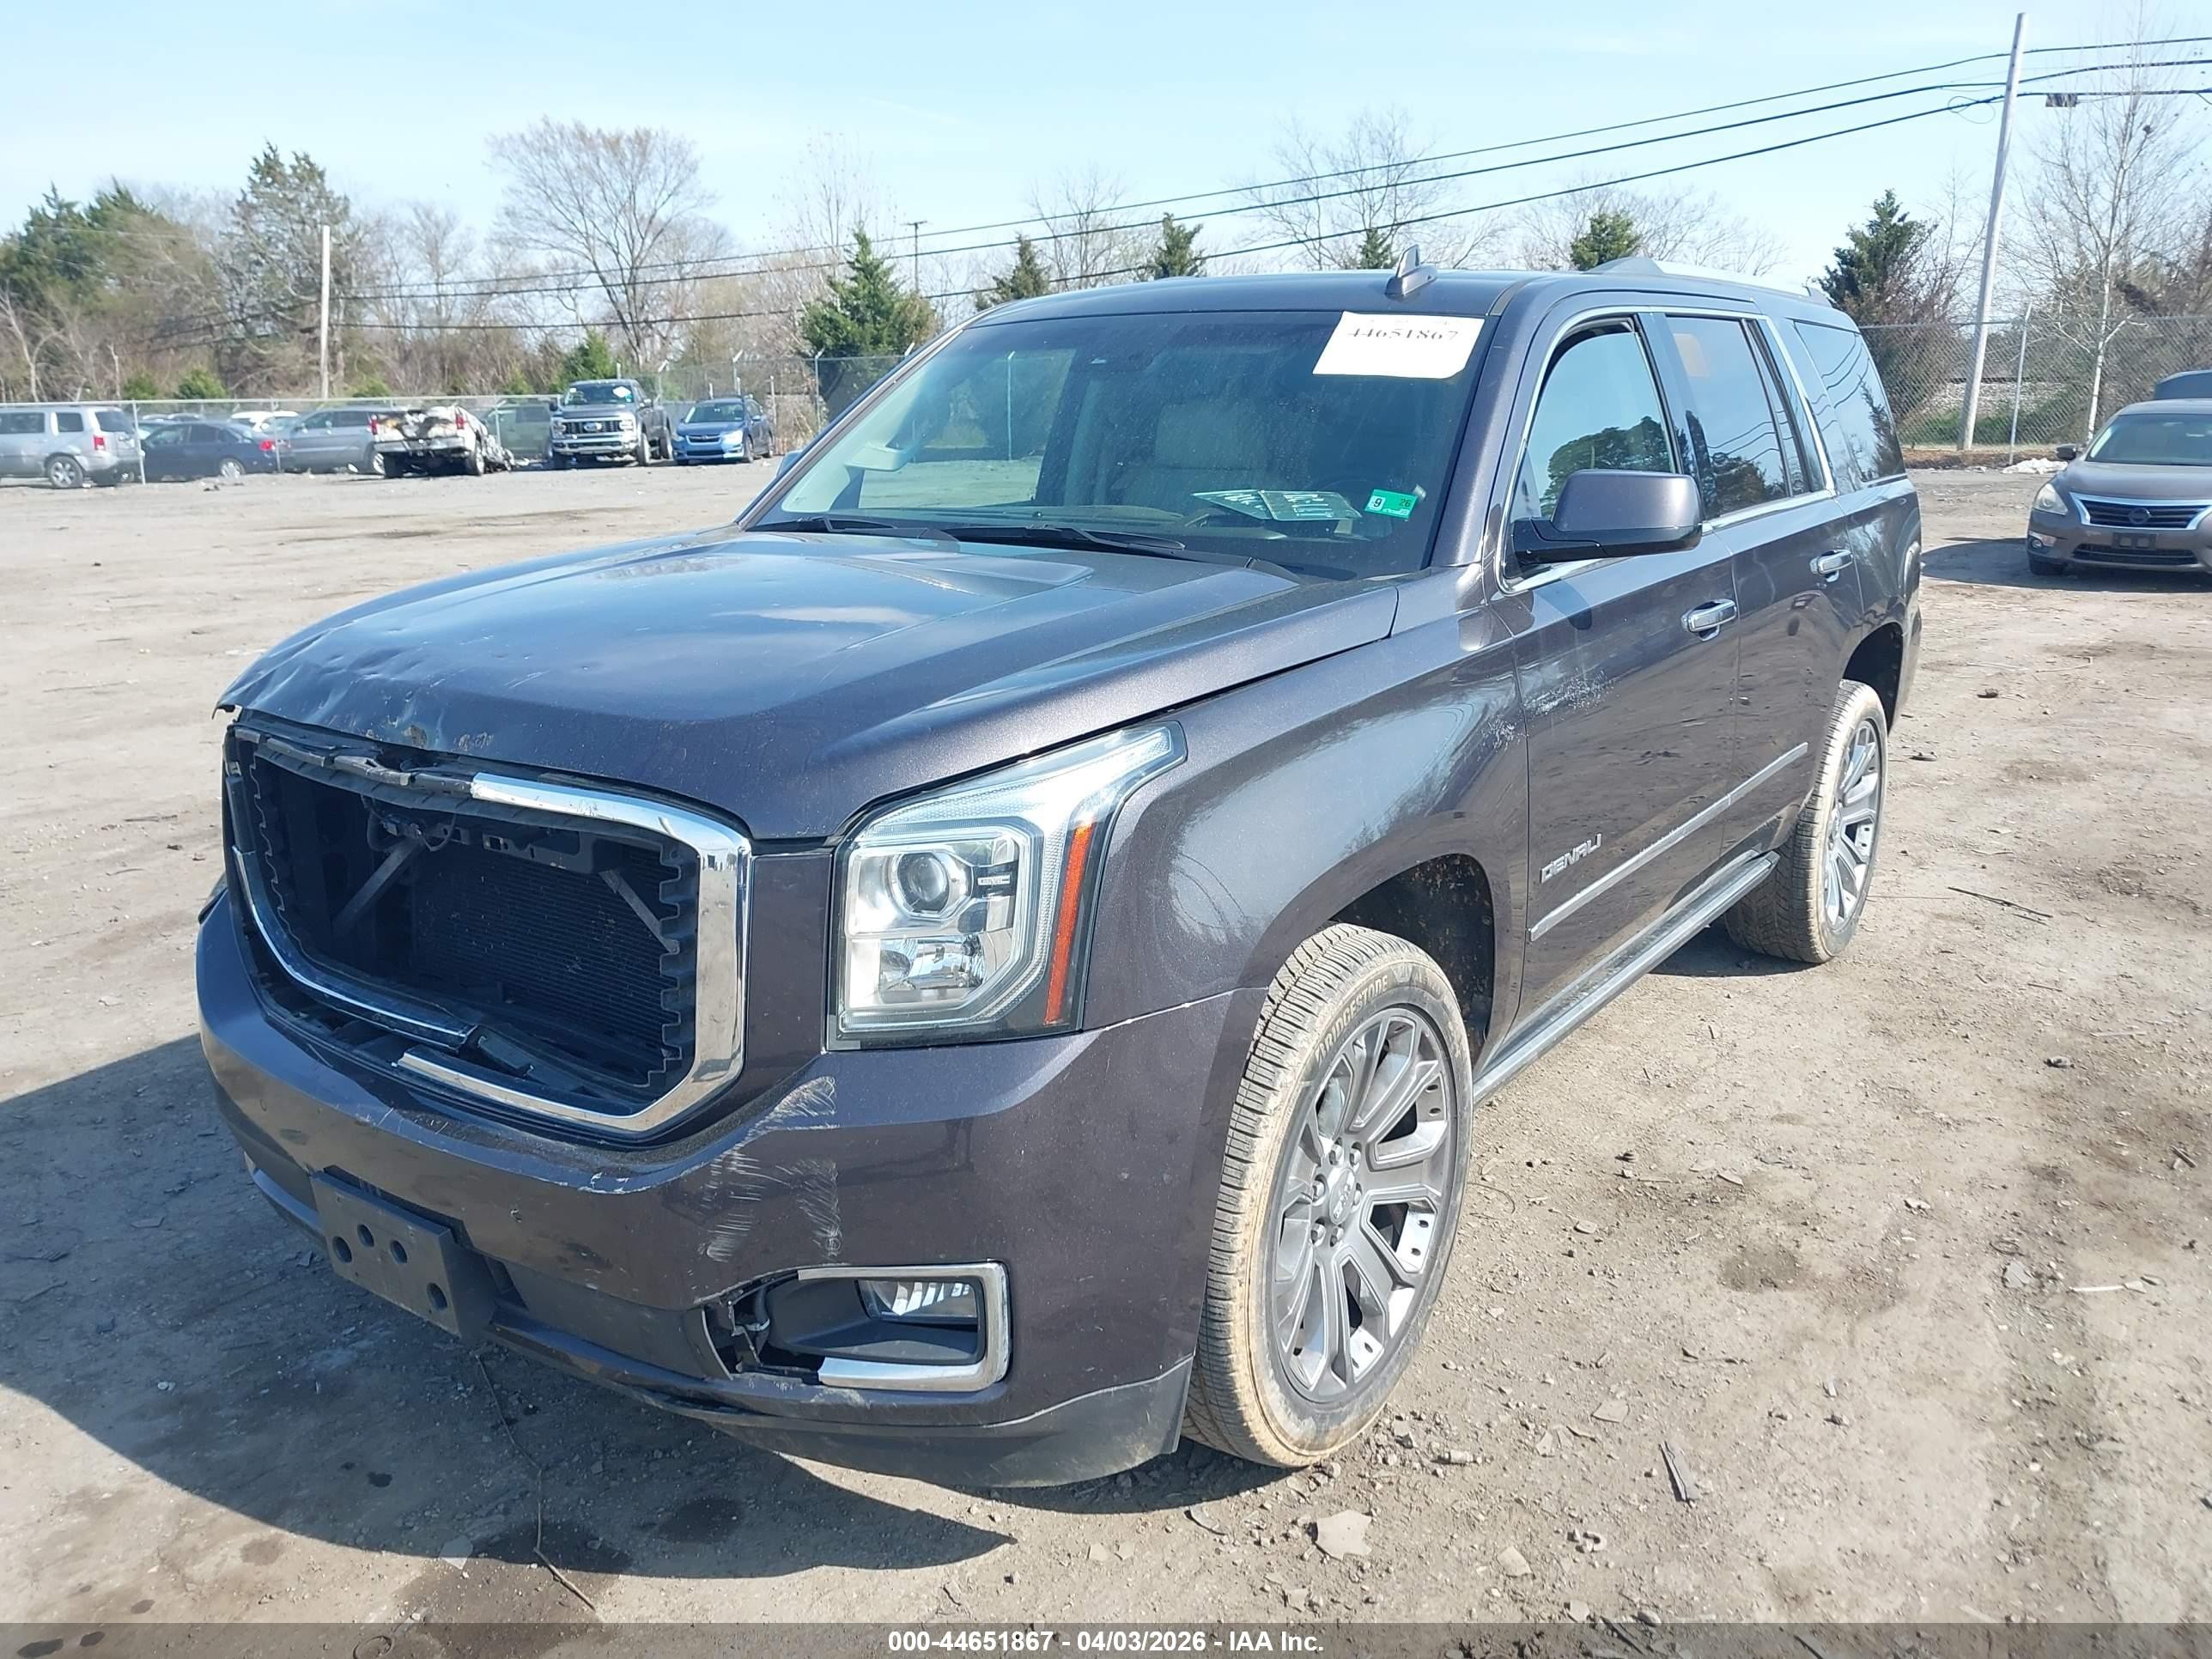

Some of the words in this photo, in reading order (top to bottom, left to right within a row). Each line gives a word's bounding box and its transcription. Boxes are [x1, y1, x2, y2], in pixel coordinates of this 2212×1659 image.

[1373, 497, 1382, 507] 9
[1399, 498, 1412, 507] 26
[1540, 833, 1602, 884] DENALI
